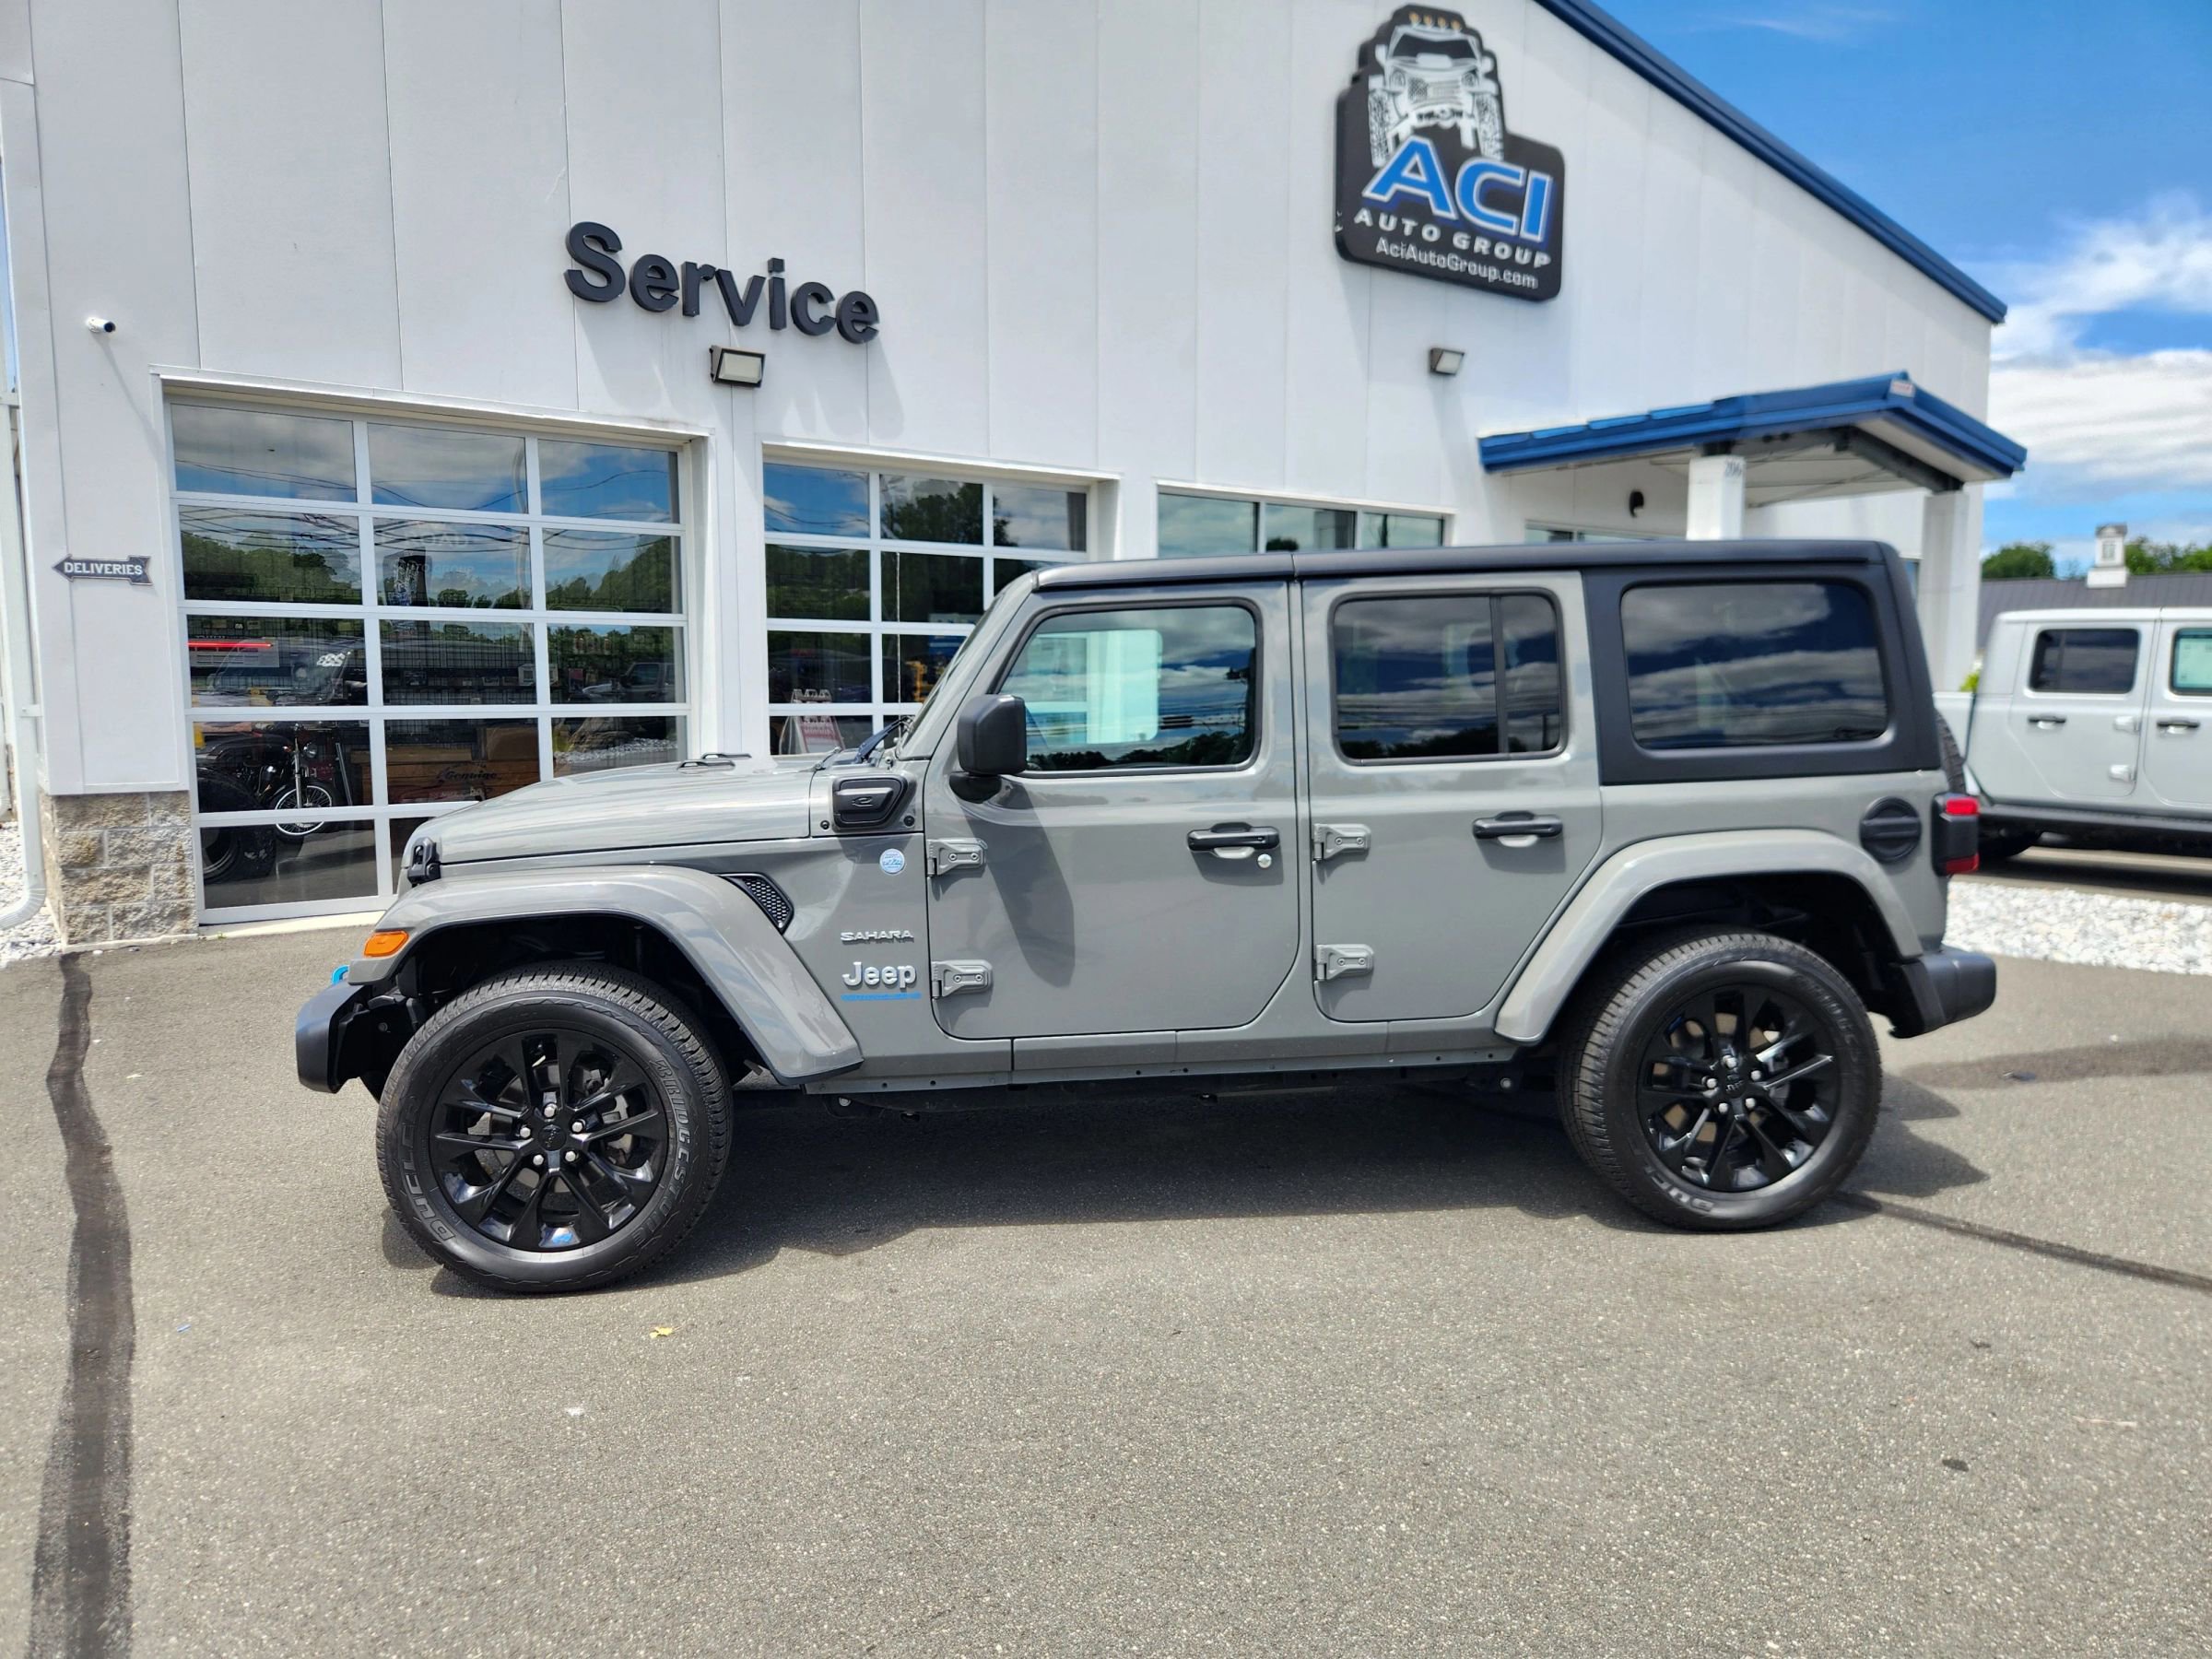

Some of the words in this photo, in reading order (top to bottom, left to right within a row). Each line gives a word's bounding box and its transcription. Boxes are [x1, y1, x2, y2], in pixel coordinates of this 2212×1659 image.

[1362, 135, 1554, 243] ACI
[1354, 207, 1441, 242] AUTO
[1452, 231, 1552, 269] GROUP
[1375, 236, 1538, 289] AciAutoGroup.com
[563, 220, 880, 345] Service
[64, 561, 144, 576] DELIVERIES
[840, 929, 915, 943] SAHARA
[841, 961, 917, 989] Jeep
